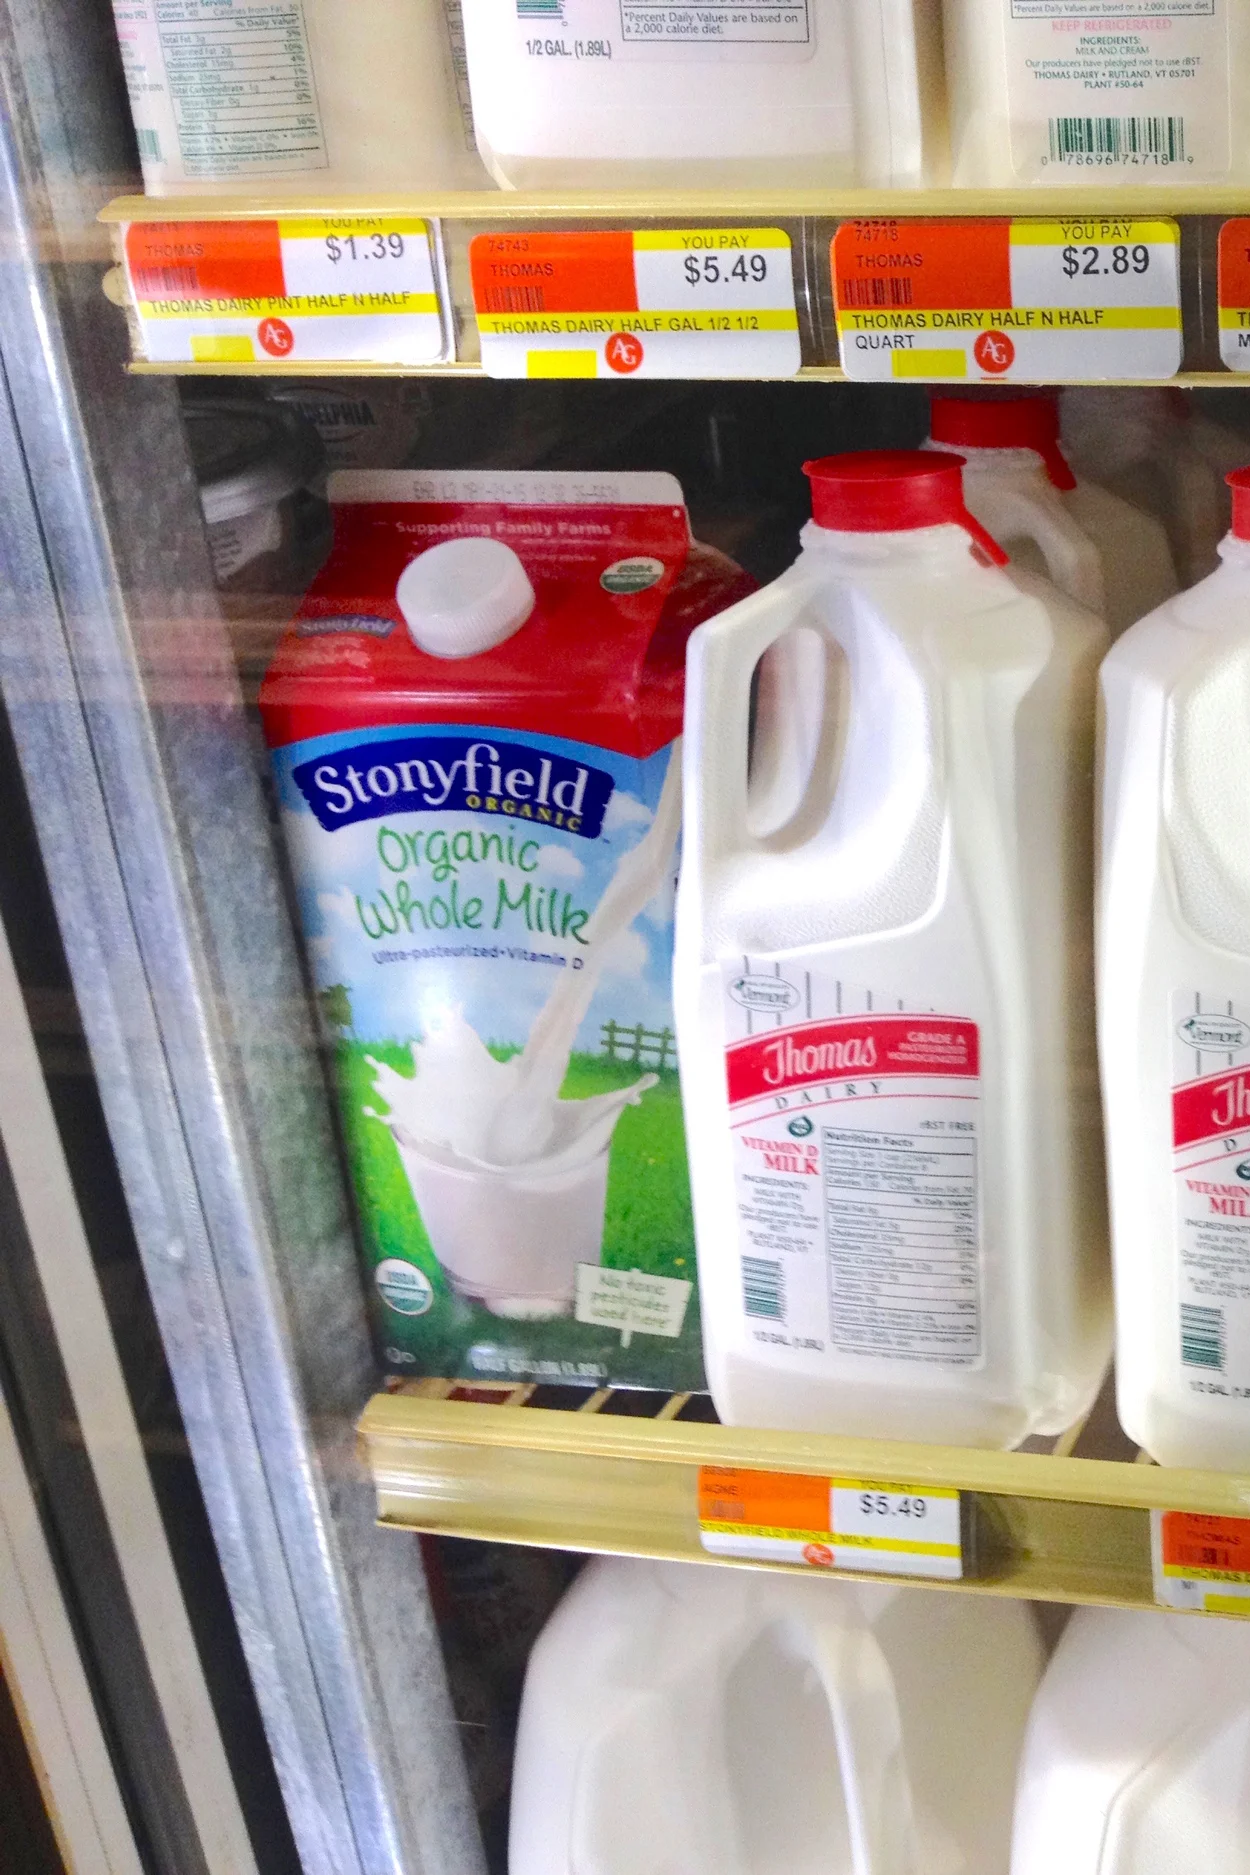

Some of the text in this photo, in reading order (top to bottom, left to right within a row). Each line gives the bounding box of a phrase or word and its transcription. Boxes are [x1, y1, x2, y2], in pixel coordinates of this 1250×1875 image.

[1052, 19, 1172, 31] KEEP REFRIGERATED
[526, 40, 611, 59] 1/2 GAL. (1.89L)
[1080, 36, 1141, 45] INGREDIENTS:
[1034, 70, 1070, 79] THOMAS
[1073, 70, 1099, 79] DAIRY
[1156, 69, 1166, 78] VT
[1169, 69, 1195, 78] 05701
[1084, 80, 1112, 88] PLANT
[1060, 225, 1131, 239] YOU PAY
[146, 244, 204, 257] THOMAS
[325, 232, 405, 264] $1.39
[682, 235, 749, 249] YOU PAY
[491, 263, 554, 276] THOMAS
[856, 254, 923, 267] THOMAS
[1063, 245, 1149, 279] $2.89
[684, 254, 766, 287] $5.49
[150, 292, 410, 313] THOMAS DAIRY PINT HALF N HALF
[492, 316, 759, 334] THOMAS DAIRY HALF GAL 1/2 1/2
[852, 310, 1104, 328] THOMAS DAIRY HALF N HALF
[856, 335, 914, 350] QUART
[396, 521, 611, 537] Supporting Family Farms
[314, 742, 589, 816] Stonyfield
[466, 794, 583, 832] ORGANIC
[377, 824, 539, 882] Organic
[355, 878, 589, 944] Whole Milk
[762, 1036, 877, 1085] Thomas
[774, 1081, 883, 1110] DAIRY
[741, 1136, 801, 1154] VITAMIN
[763, 1153, 820, 1176] MILK
[1186, 1179, 1250, 1198] VITAMIN
[859, 1493, 927, 1518] $5.49
